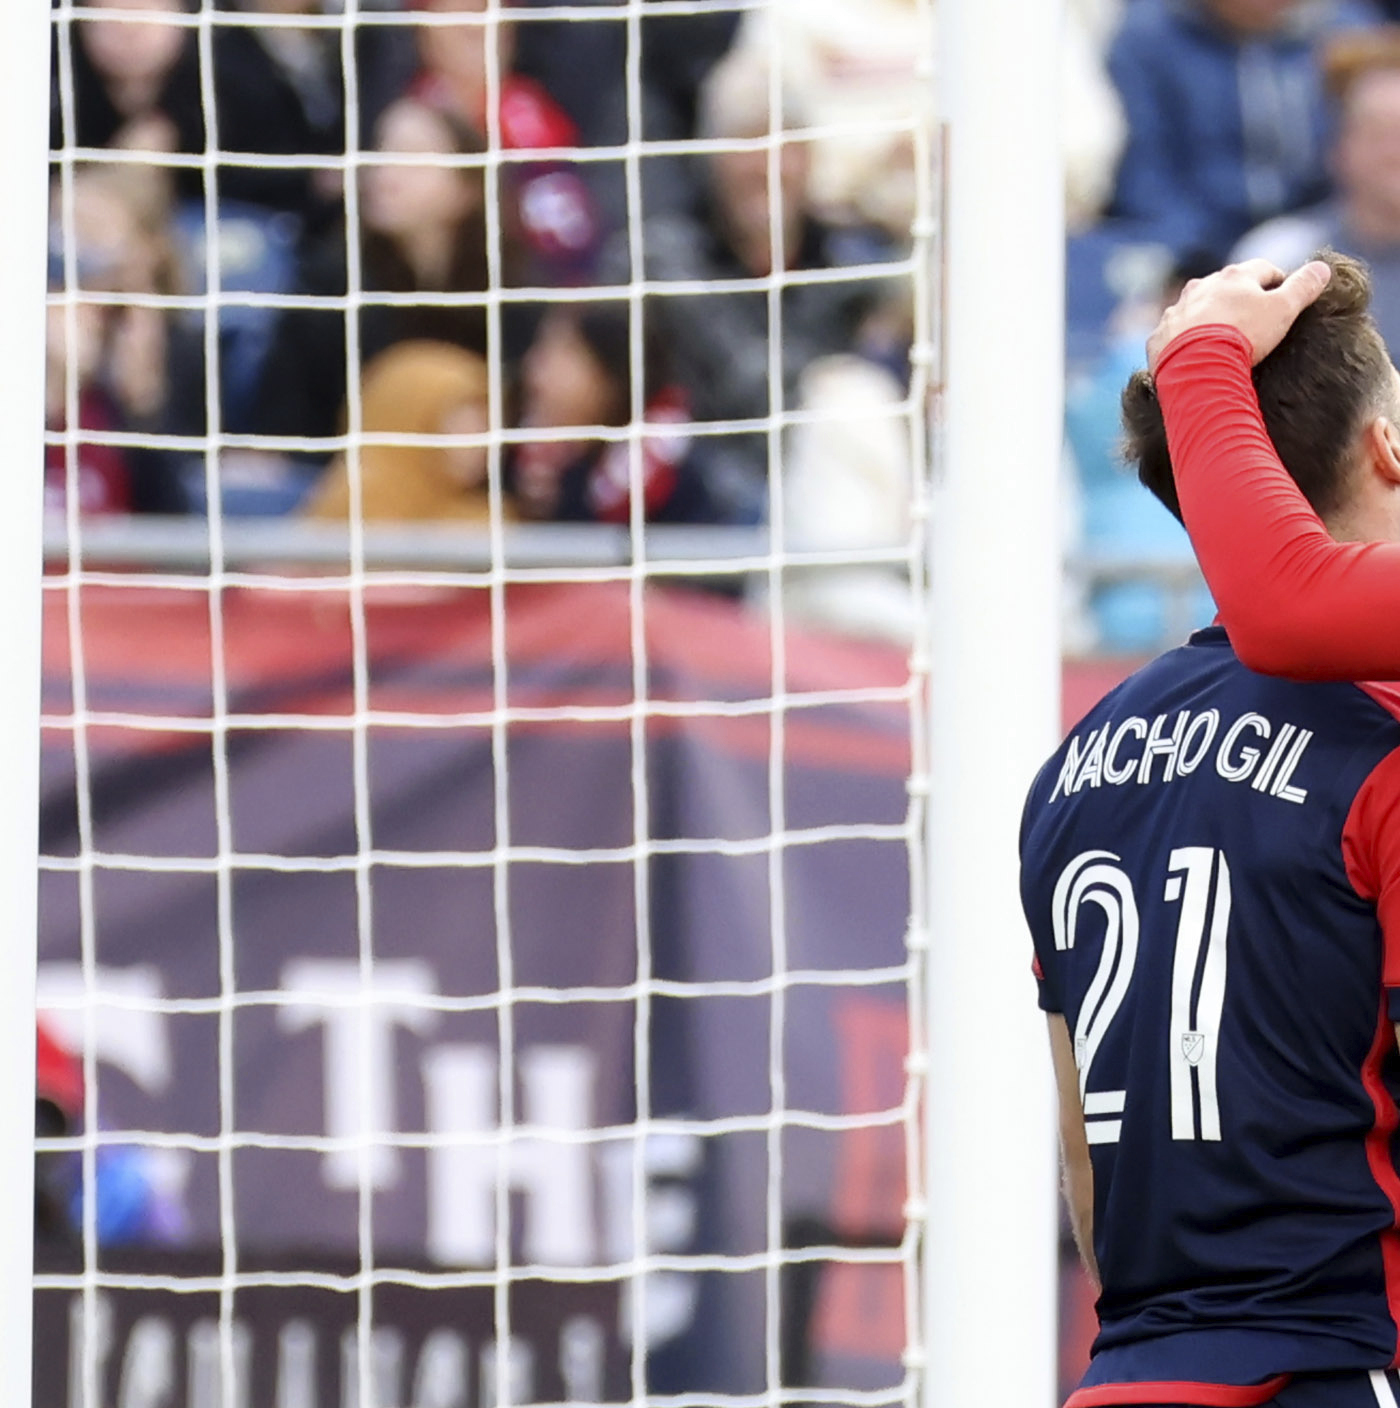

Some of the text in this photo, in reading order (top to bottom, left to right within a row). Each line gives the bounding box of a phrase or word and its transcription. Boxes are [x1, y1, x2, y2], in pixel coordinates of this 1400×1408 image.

[1048, 708, 1314, 804] NACHO GIL
[1052, 846, 1232, 1145] 21
